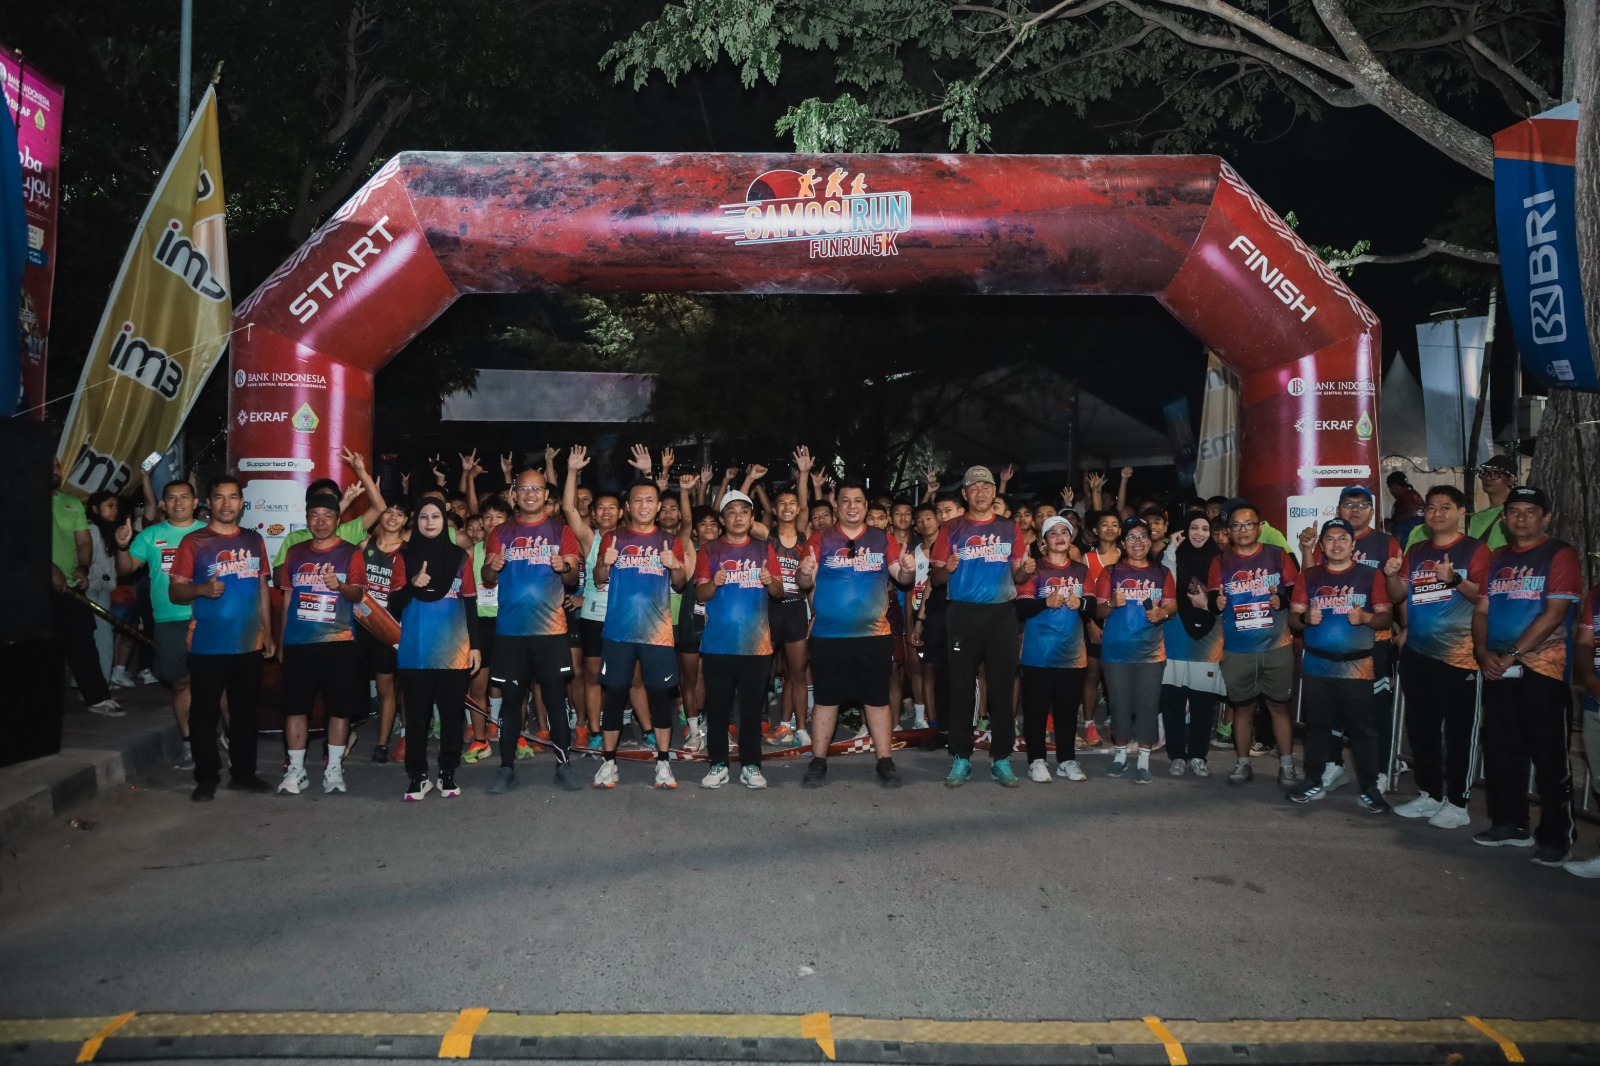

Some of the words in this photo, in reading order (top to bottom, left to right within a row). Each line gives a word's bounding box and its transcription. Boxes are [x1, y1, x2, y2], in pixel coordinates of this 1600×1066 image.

[1522, 189, 1559, 285] BRI
[289, 215, 394, 324] START
[1229, 235, 1317, 323] FINISH
[109, 324, 183, 399] im3
[247, 373, 269, 382] BANK
[272, 373, 327, 384] INDONESIA
[250, 411, 289, 422] EKRAF
[1314, 420, 1354, 430] EKRAF
[1301, 508, 1318, 517] BRI
[1236, 609, 1270, 620] 50907
